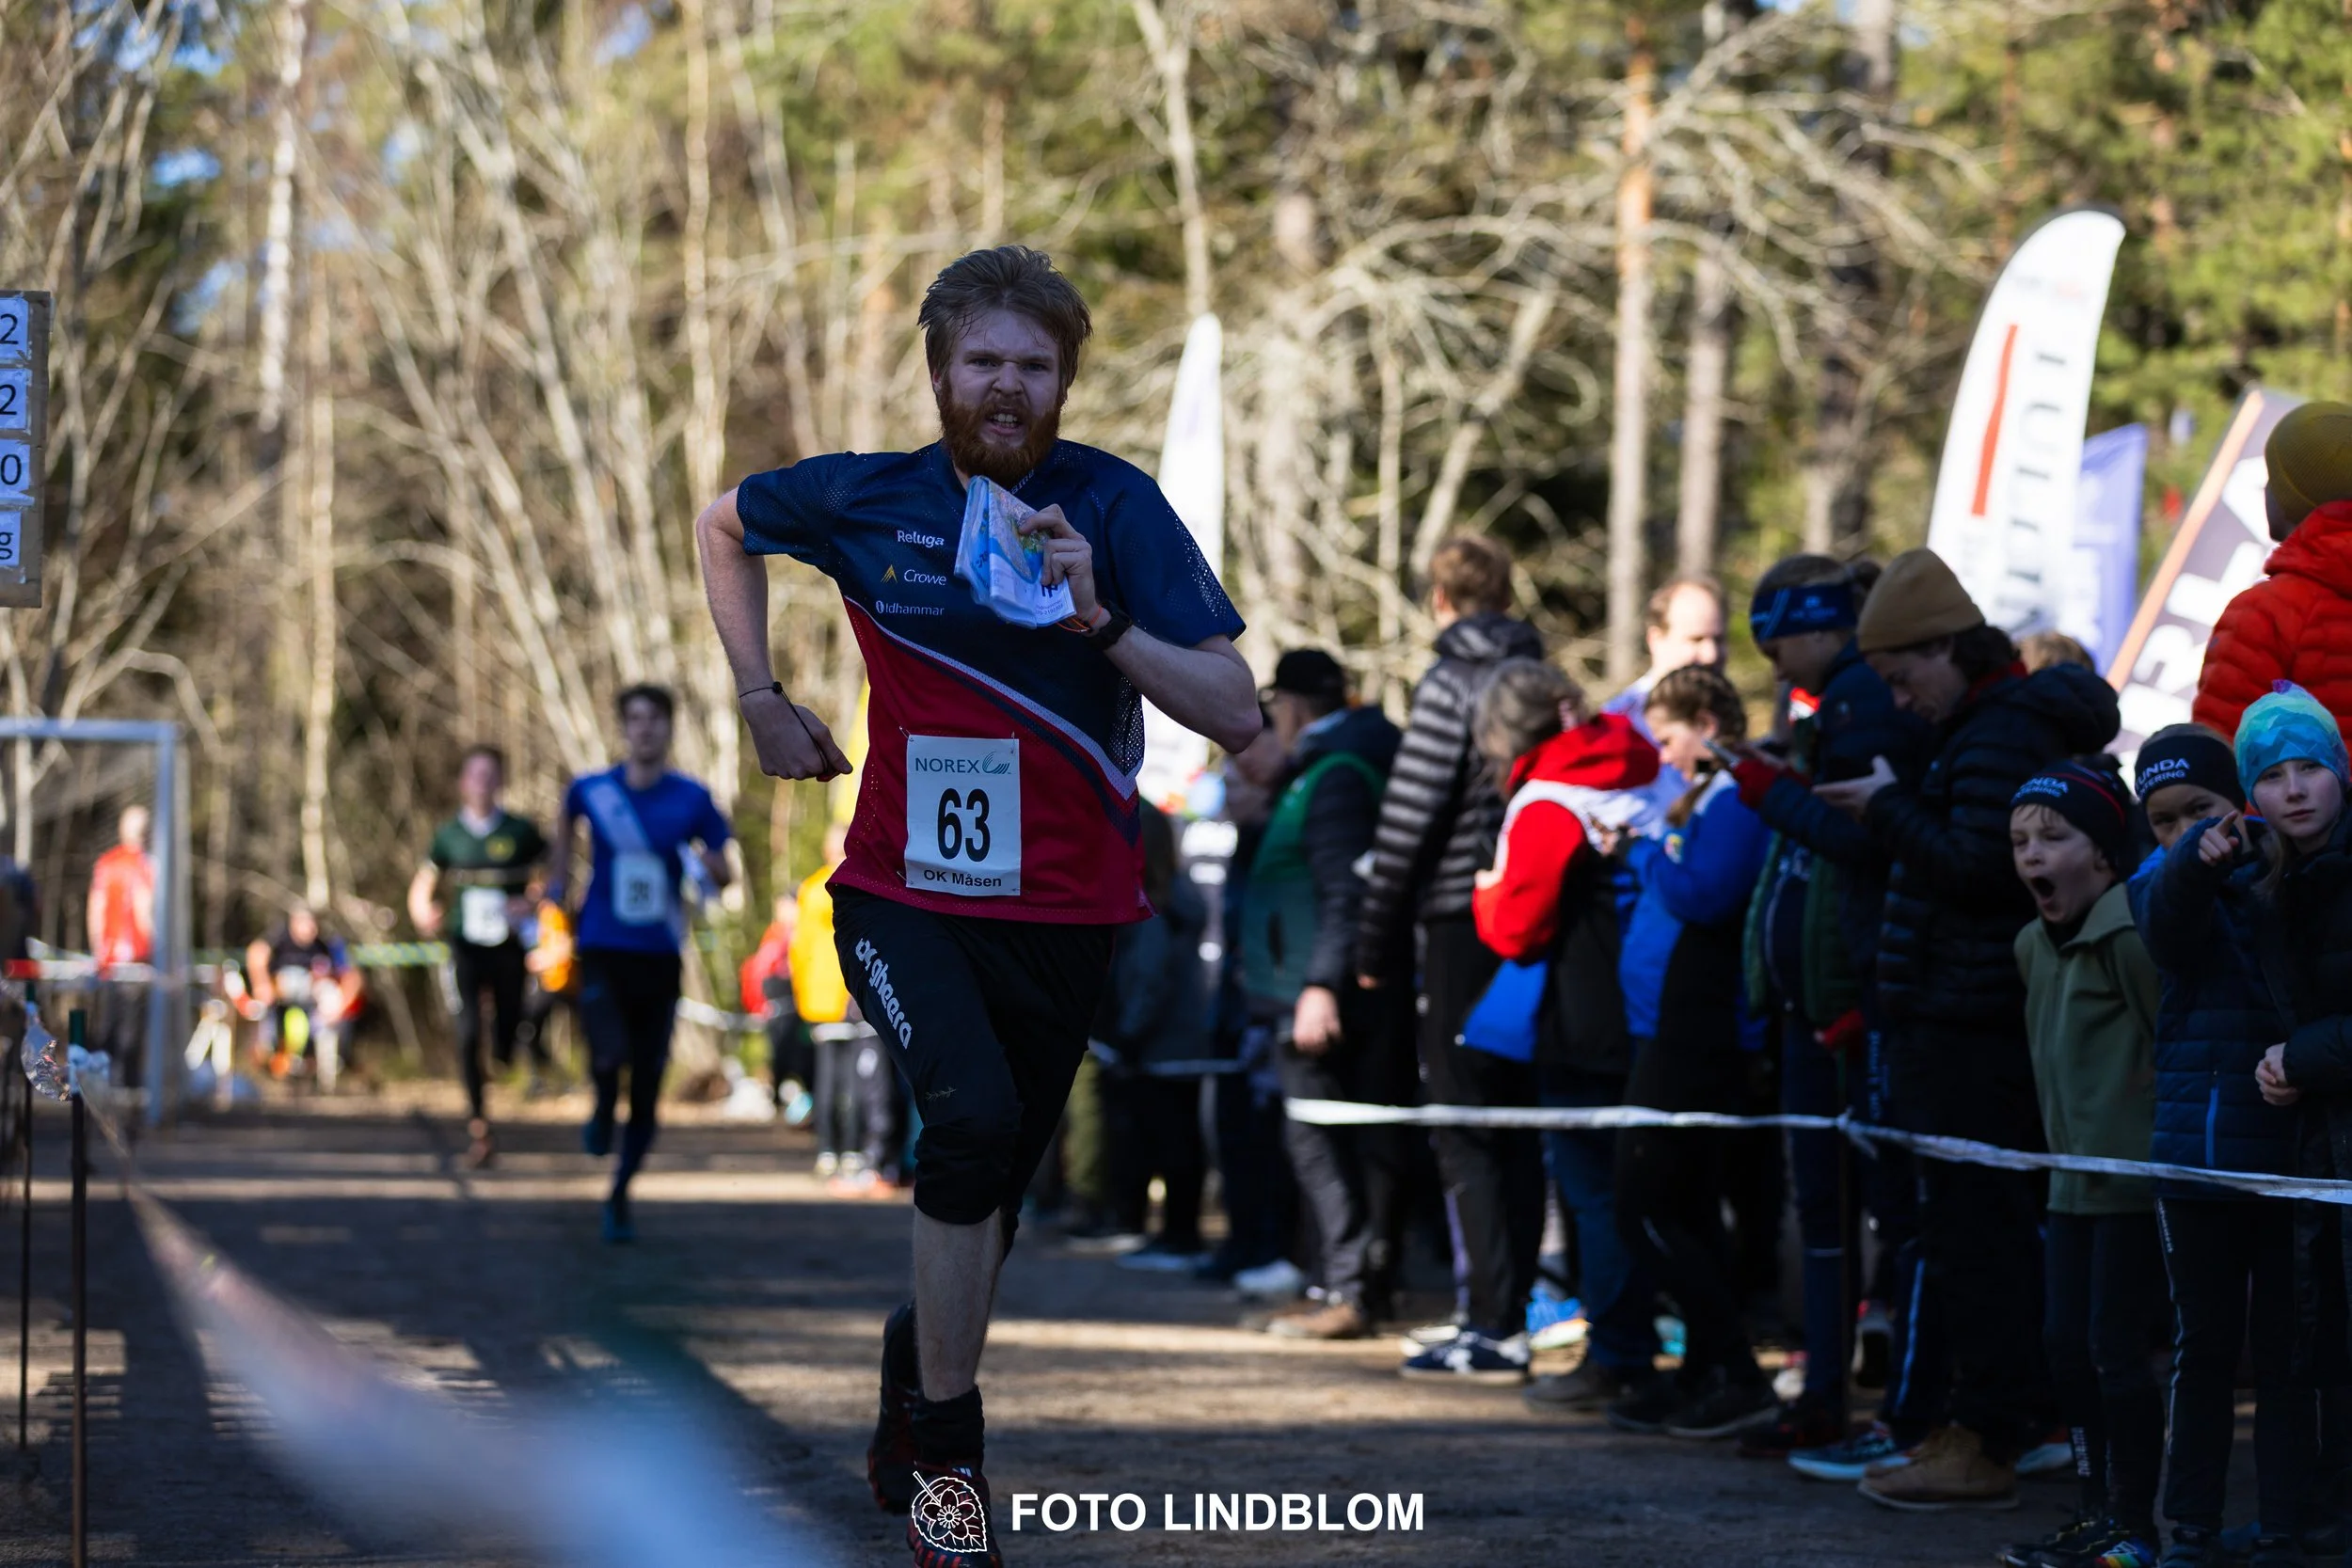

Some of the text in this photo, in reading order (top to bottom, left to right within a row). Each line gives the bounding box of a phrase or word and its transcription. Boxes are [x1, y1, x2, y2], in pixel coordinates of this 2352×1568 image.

[0, 313, 19, 344] 2
[0, 384, 17, 415] 2
[897, 530, 945, 547] Reluga
[904, 569, 946, 585] Crowe
[915, 757, 980, 773] NOREX
[937, 787, 991, 863] 63
[924, 869, 1002, 887] OK Måsen
